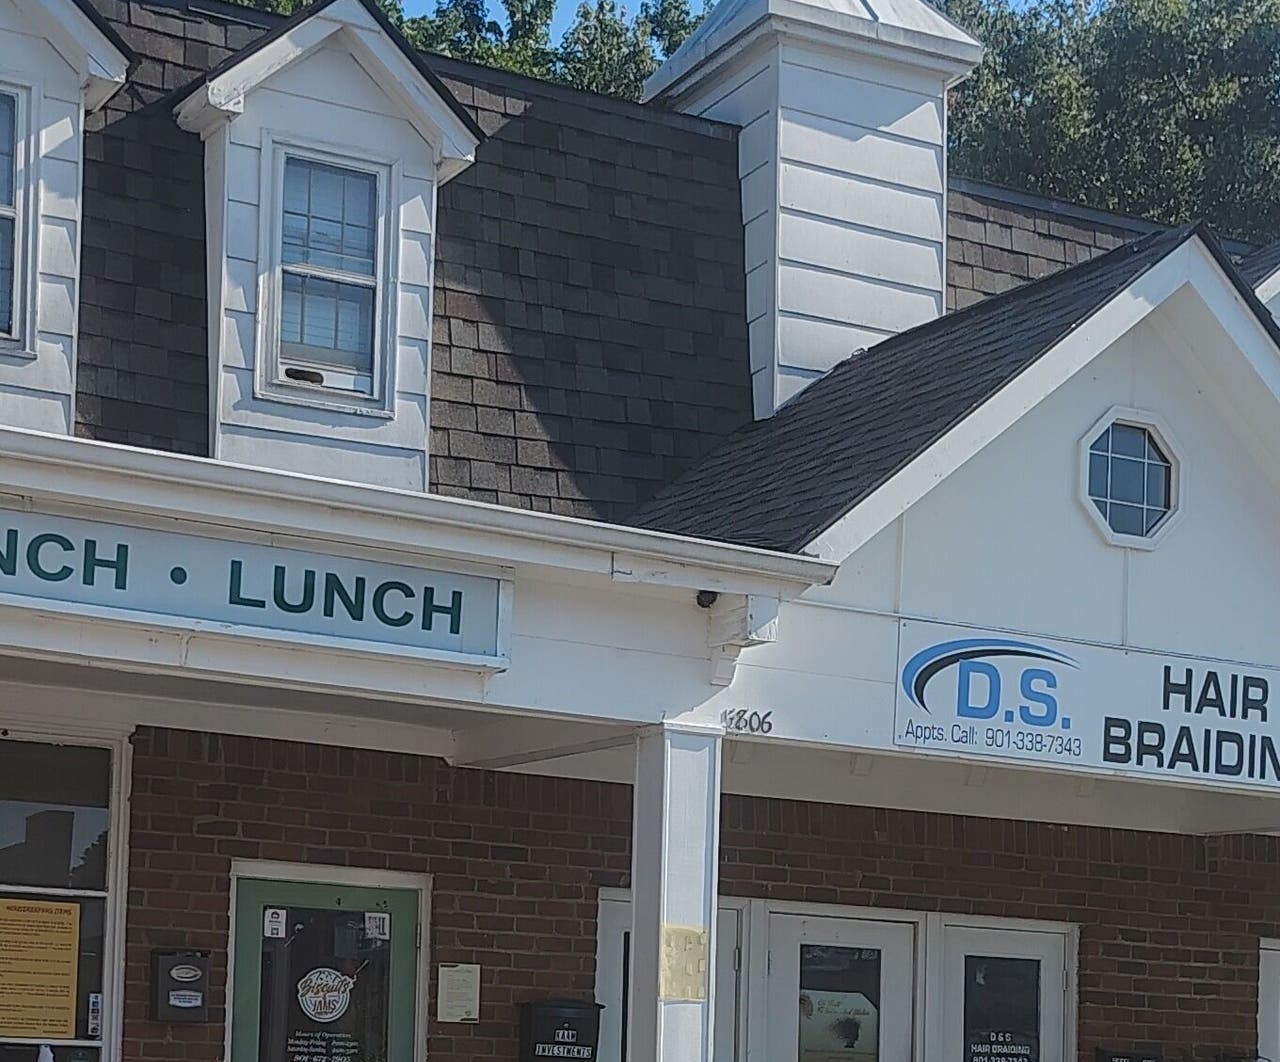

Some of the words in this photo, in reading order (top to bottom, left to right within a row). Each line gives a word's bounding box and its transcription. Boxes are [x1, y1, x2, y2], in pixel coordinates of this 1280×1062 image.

[228, 559, 464, 636] LUNCH
[956, 659, 1072, 730] D.S.
[1162, 664, 1270, 723] HAIR
[904, 718, 948, 745] Appts.
[950, 724, 979, 745] Call:
[984, 727, 1083, 758] 901-338-7343
